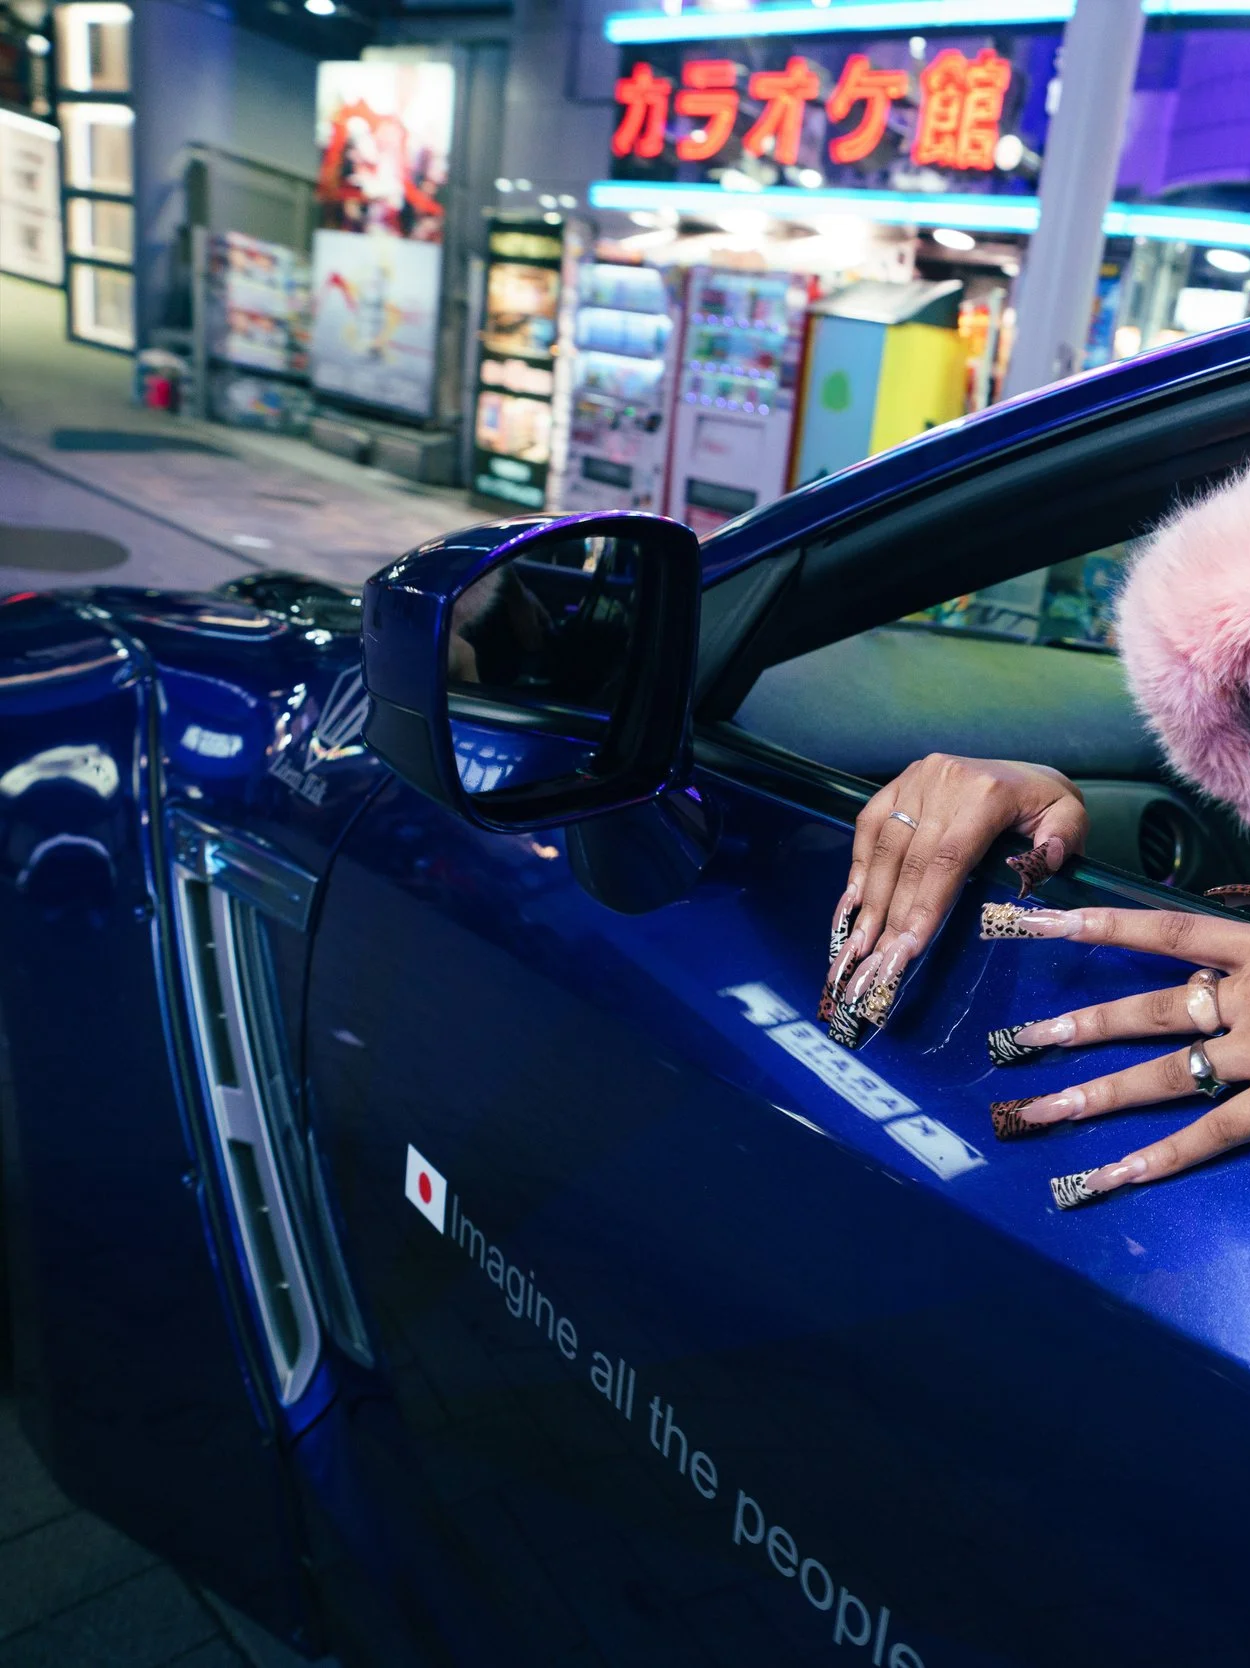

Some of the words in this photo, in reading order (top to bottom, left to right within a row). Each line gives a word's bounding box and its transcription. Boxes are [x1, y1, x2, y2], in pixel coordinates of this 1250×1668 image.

[612, 48, 1011, 171] カラオケ館
[451, 1195, 578, 1360] Imagine
[590, 1351, 636, 1421] all
[649, 1395, 719, 1500] the
